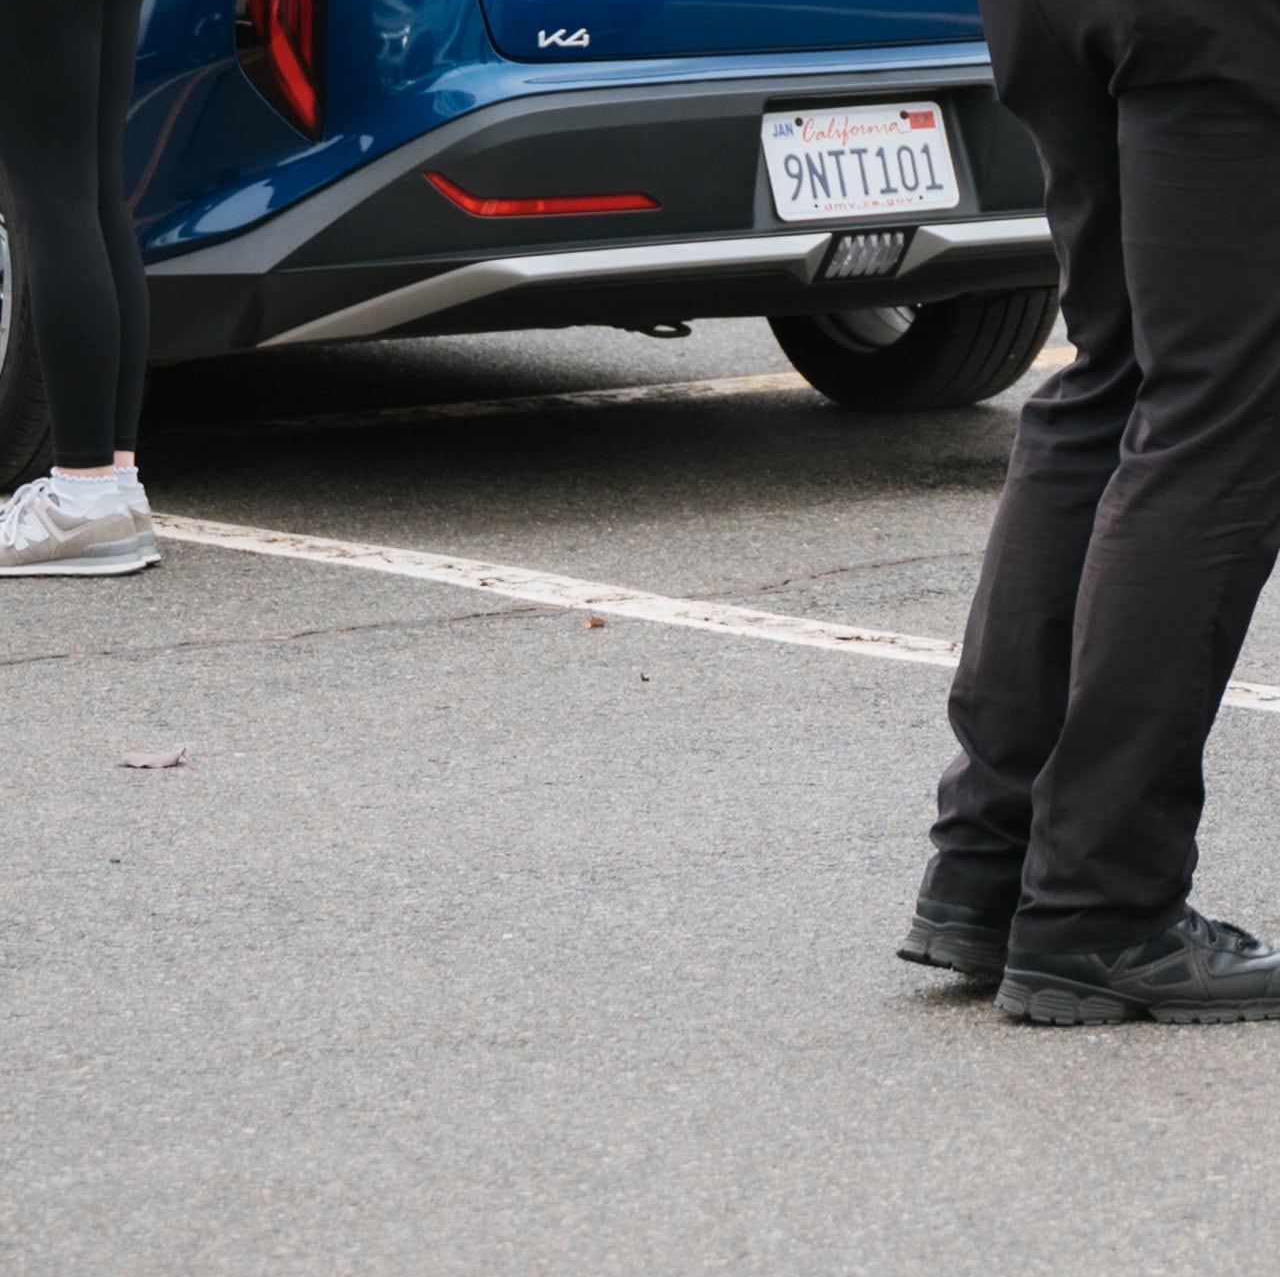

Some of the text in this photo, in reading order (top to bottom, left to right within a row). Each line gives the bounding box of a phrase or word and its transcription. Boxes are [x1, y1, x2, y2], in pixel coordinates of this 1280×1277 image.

[538, 27, 590, 49] K4
[772, 115, 909, 147] JAN California
[784, 143, 944, 202] 9NTT101
[823, 196, 914, 211] dmv.ca.gov
